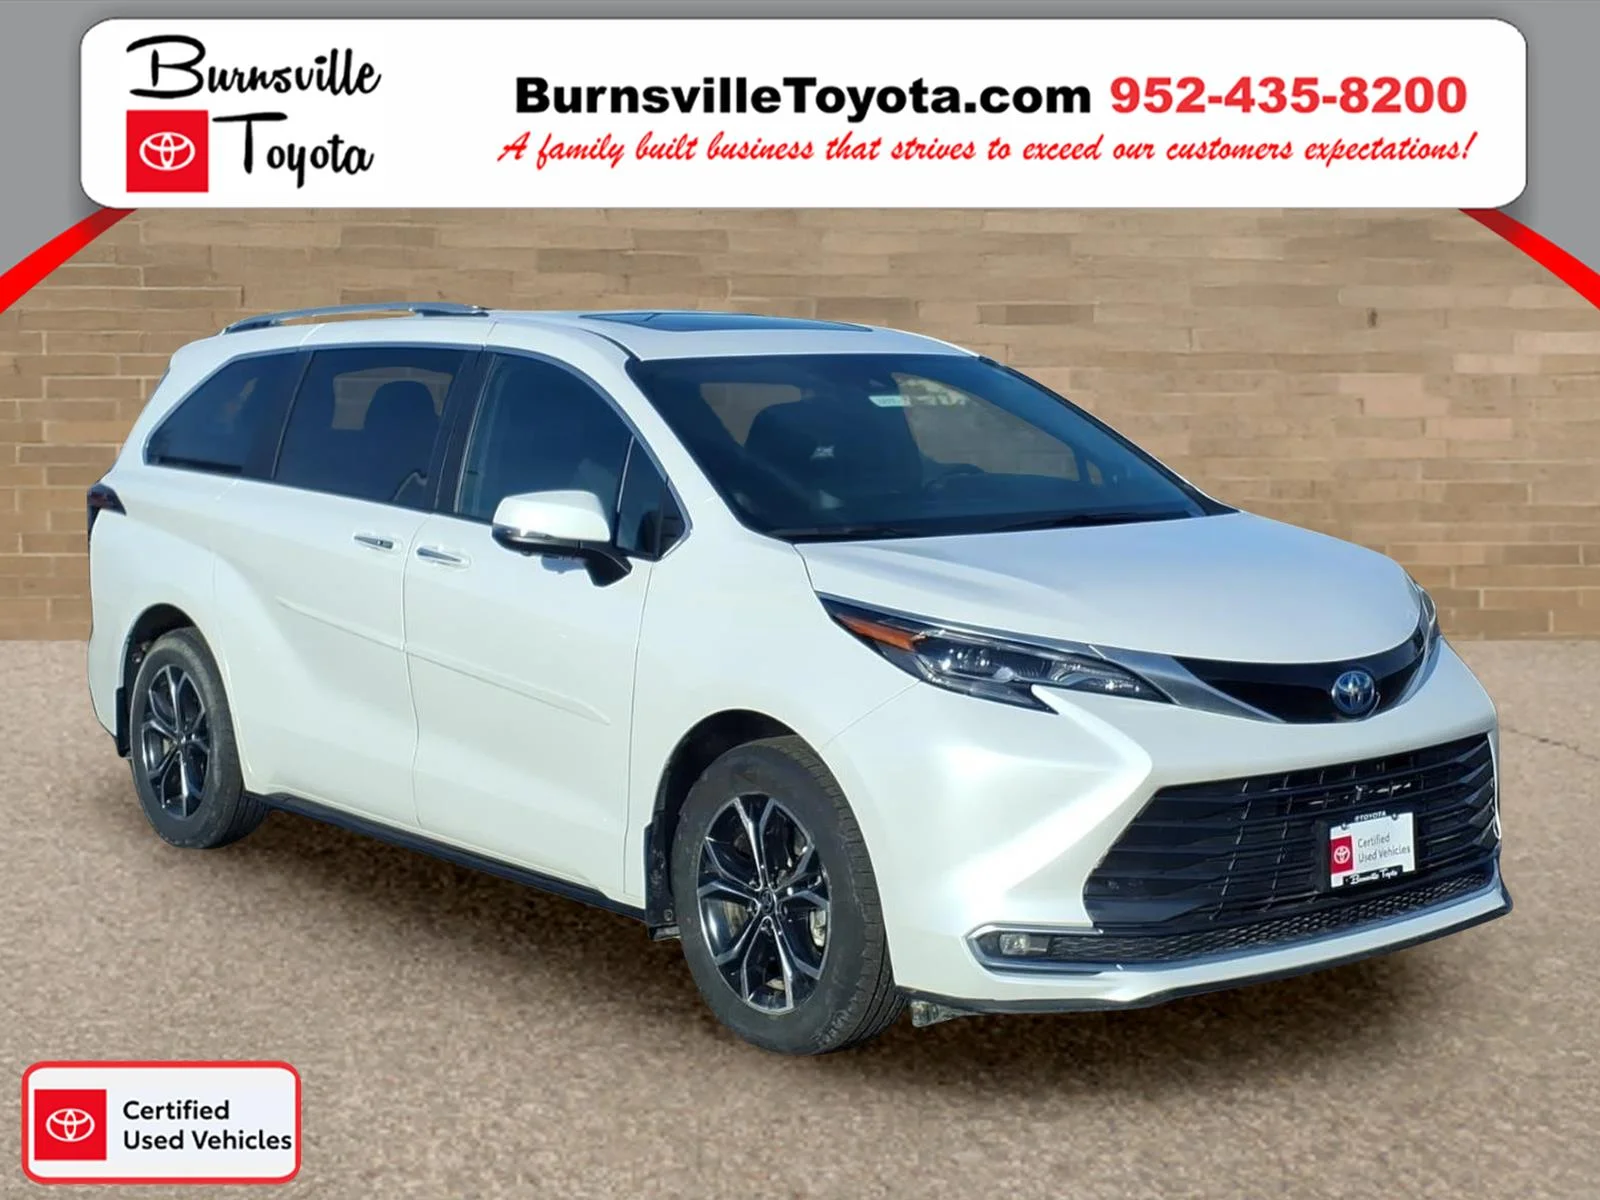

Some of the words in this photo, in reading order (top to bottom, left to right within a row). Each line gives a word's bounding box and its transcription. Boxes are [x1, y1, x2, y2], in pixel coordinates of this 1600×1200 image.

[1357, 833, 1391, 848] Certified
[1358, 851, 1377, 863] Used
[1379, 845, 1411, 859] Vehicles
